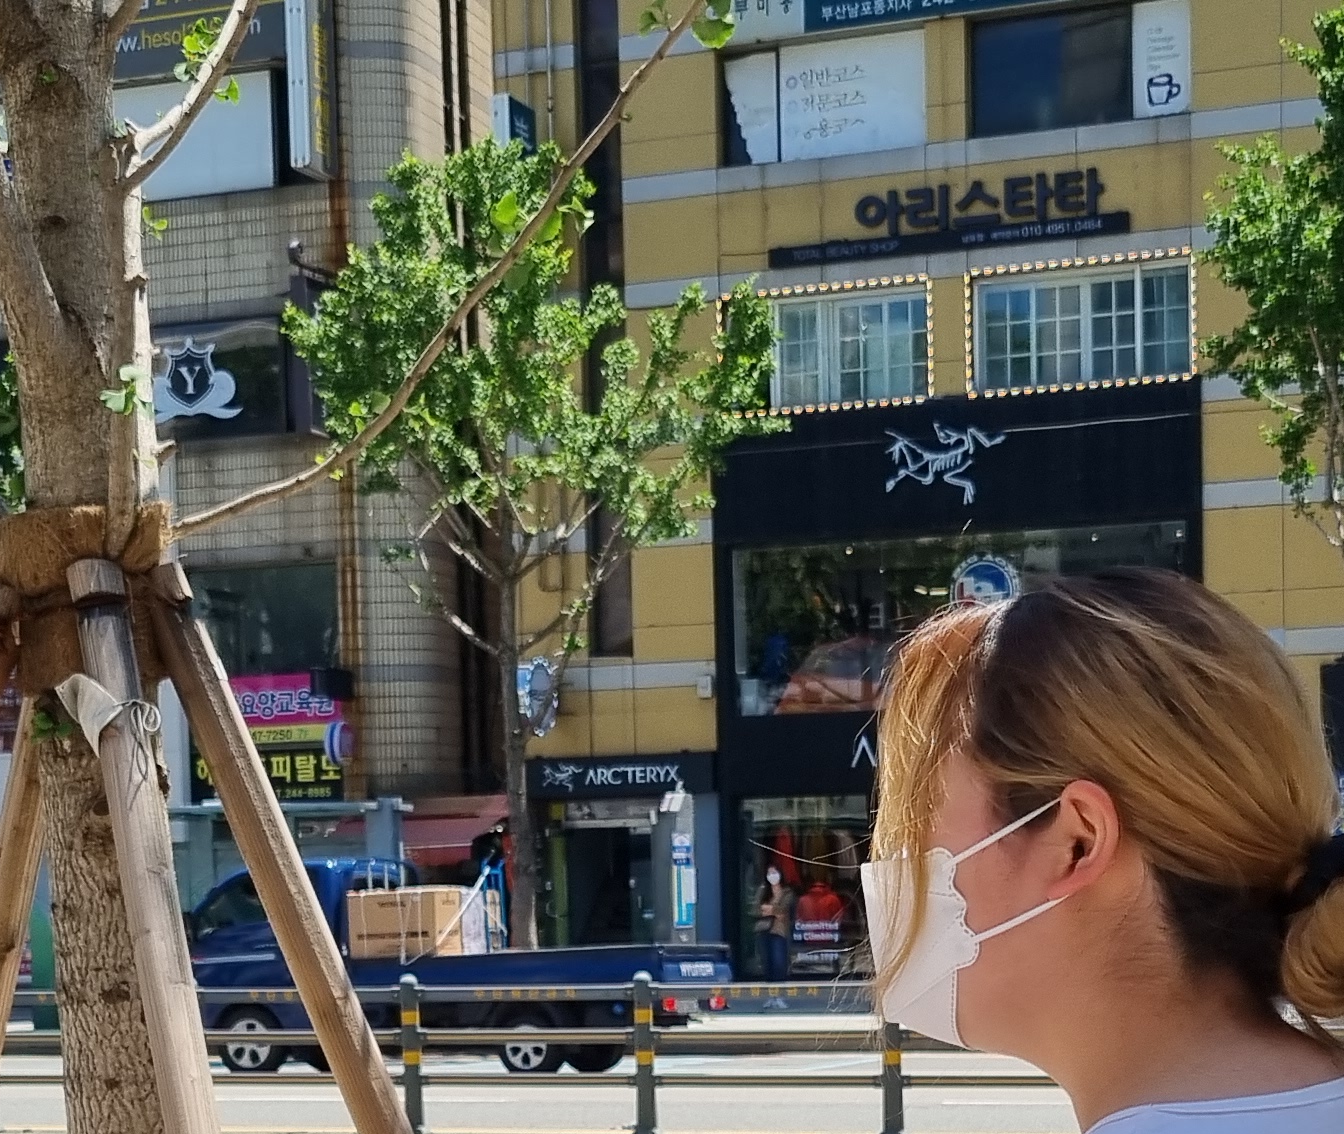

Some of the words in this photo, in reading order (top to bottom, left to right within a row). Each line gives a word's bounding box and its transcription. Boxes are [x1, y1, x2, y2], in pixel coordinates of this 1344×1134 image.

[825, 244, 866, 257] BEAUTY
[869, 240, 900, 253] SHOP
[251, 729, 293, 742] 47-7250
[262, 754, 342, 783] 피탈모
